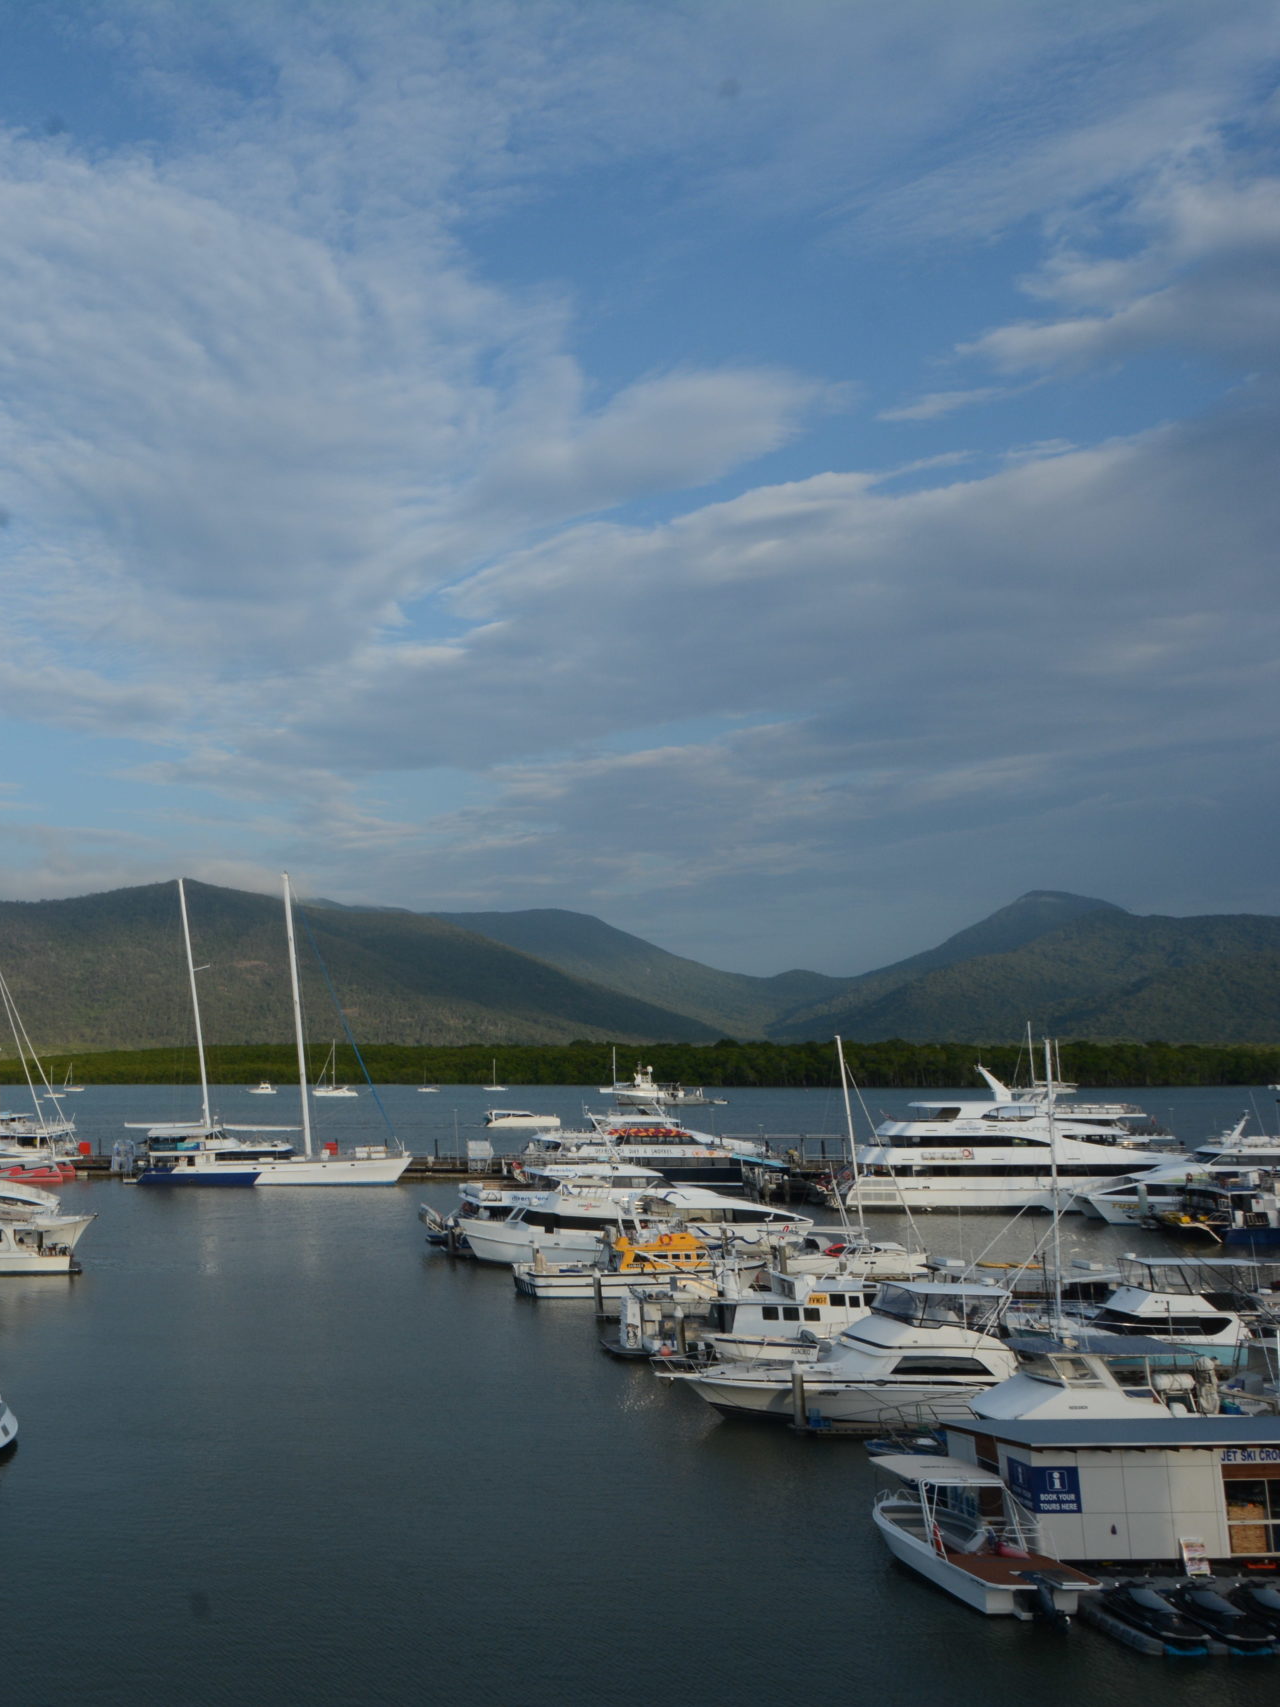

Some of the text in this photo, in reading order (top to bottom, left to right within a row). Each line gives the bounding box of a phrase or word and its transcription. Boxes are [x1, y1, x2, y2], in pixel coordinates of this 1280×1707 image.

[1221, 1450, 1238, 1462] JET
[1241, 1449, 1256, 1461] SKI
[1039, 1493, 1076, 1501] BOOK YOUR
[1040, 1503, 1060, 1511] TOURS
